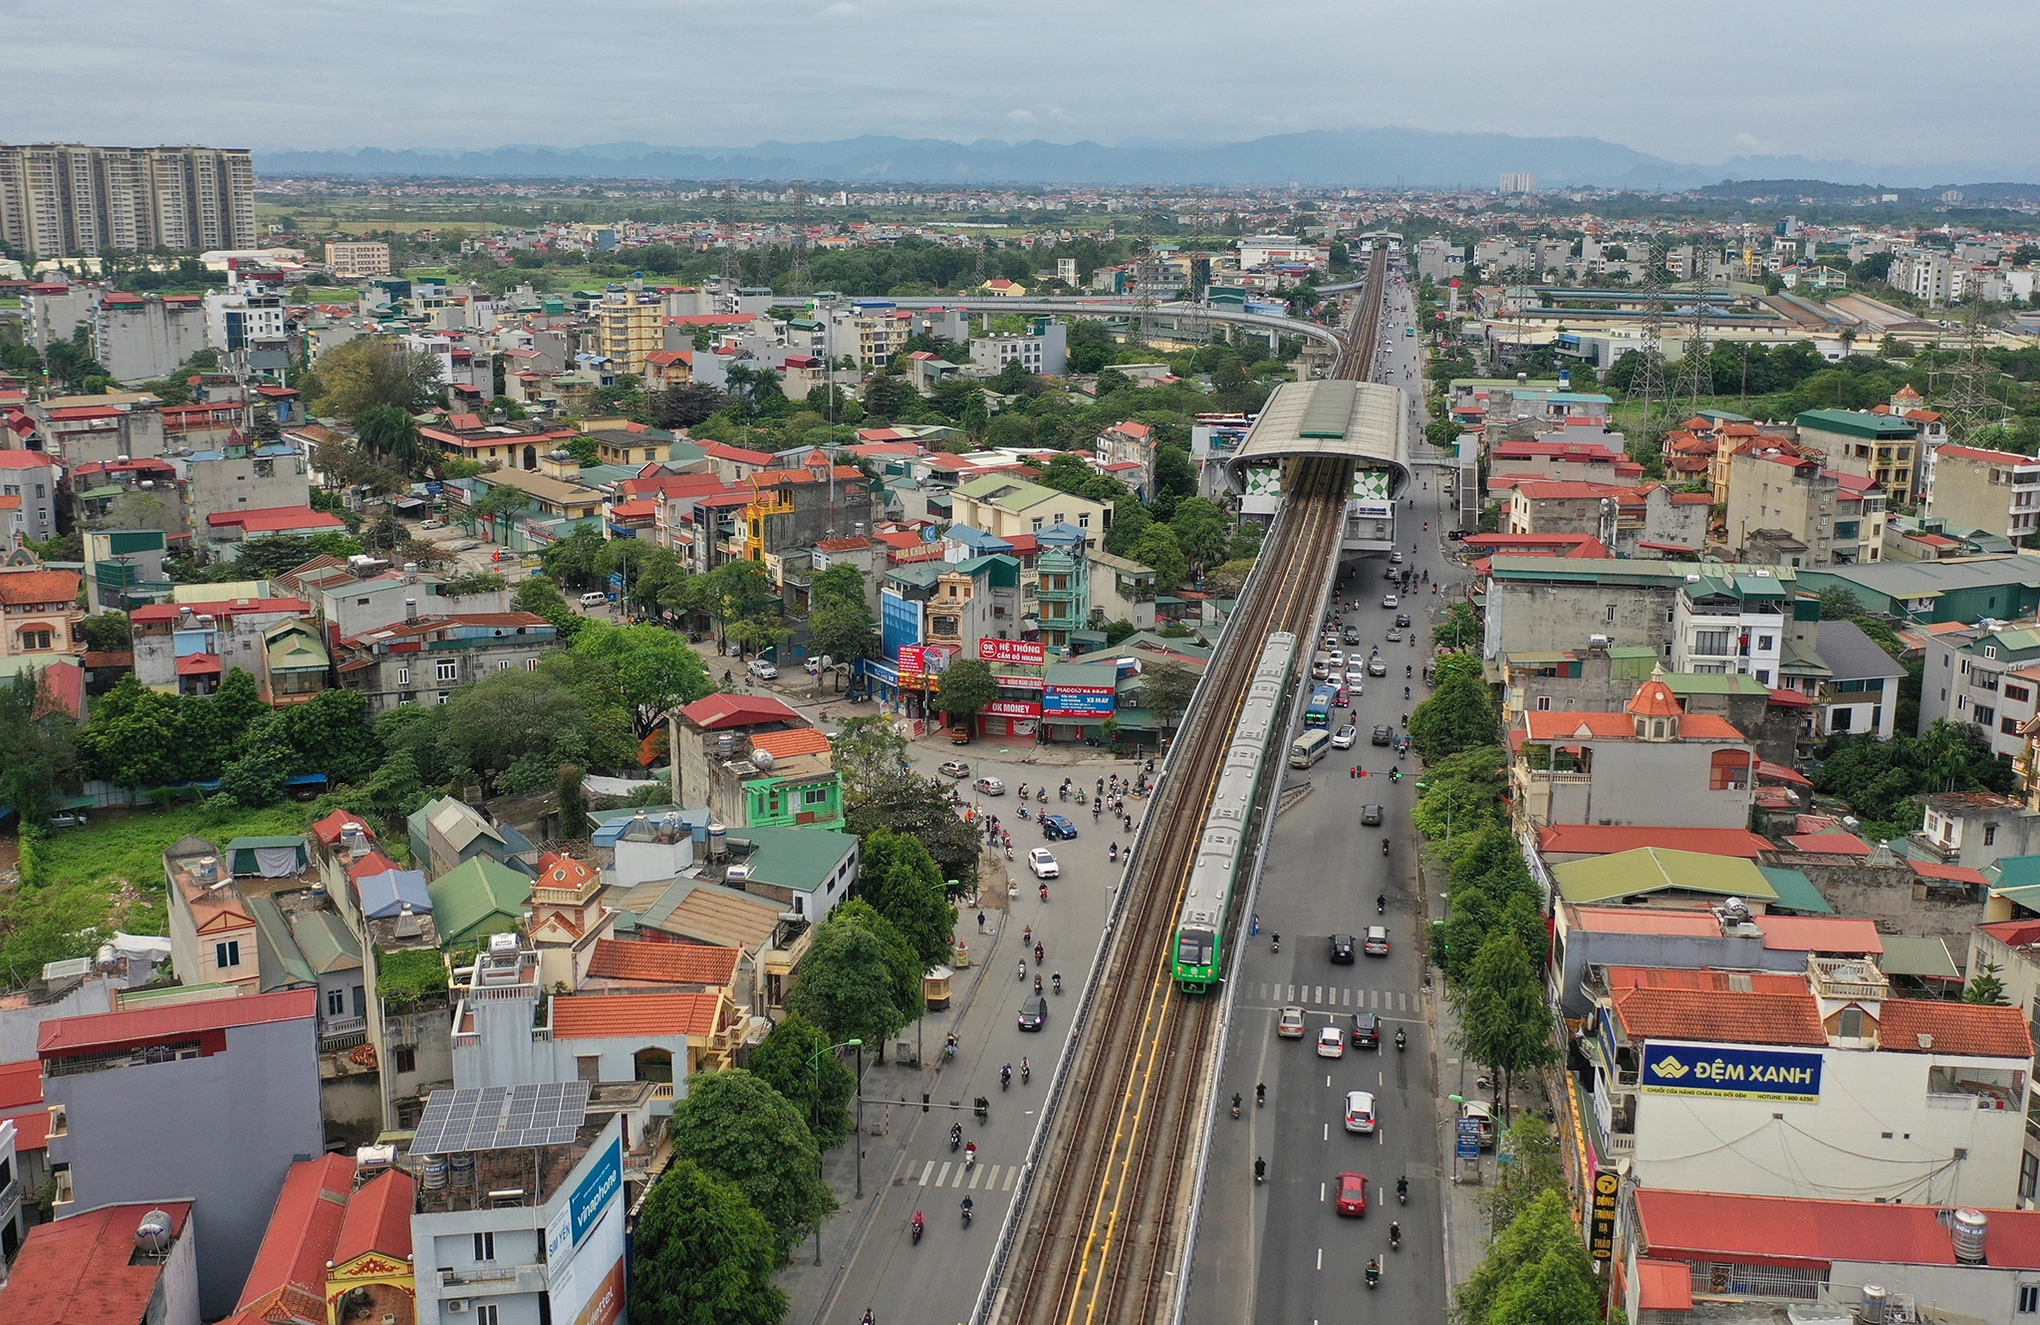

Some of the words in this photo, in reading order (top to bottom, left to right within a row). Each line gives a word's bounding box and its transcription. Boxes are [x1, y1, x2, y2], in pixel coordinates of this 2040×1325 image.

[992, 703, 1003, 712] OK
[1003, 703, 1030, 714] MONEY
[1694, 1058, 1744, 1083] ĐỆM
[1748, 1065, 1811, 1085] XANH
[577, 1169, 617, 1227] vinaphone
